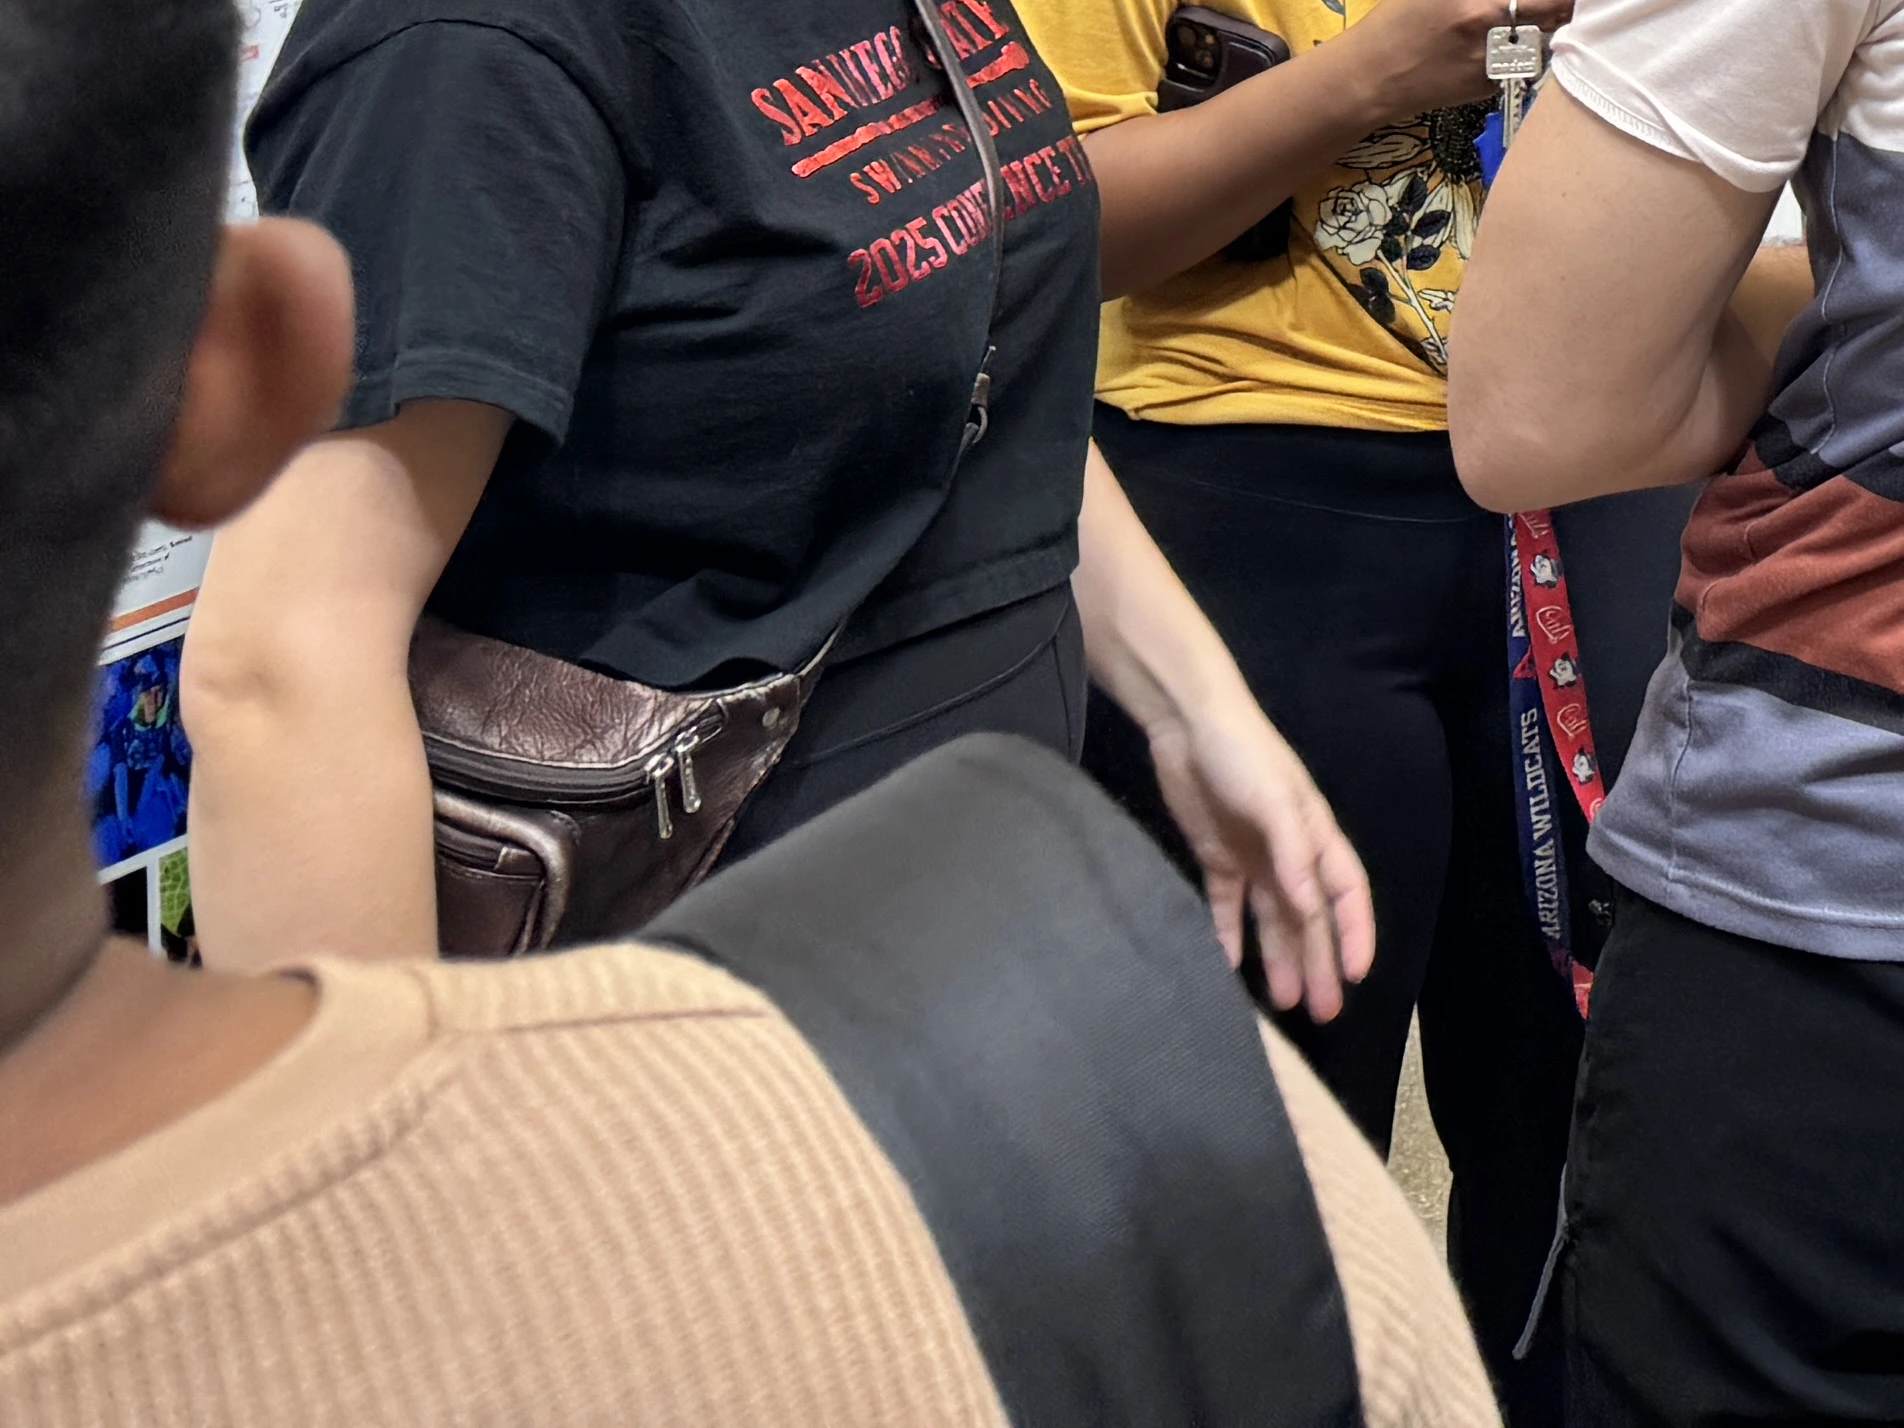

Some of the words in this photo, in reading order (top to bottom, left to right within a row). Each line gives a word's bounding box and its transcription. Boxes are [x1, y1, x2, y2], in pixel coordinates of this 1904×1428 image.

[847, 215, 949, 309] 2025
[1520, 707, 1553, 842] WILDCATS
[1533, 837, 1562, 941] ARIZONA
